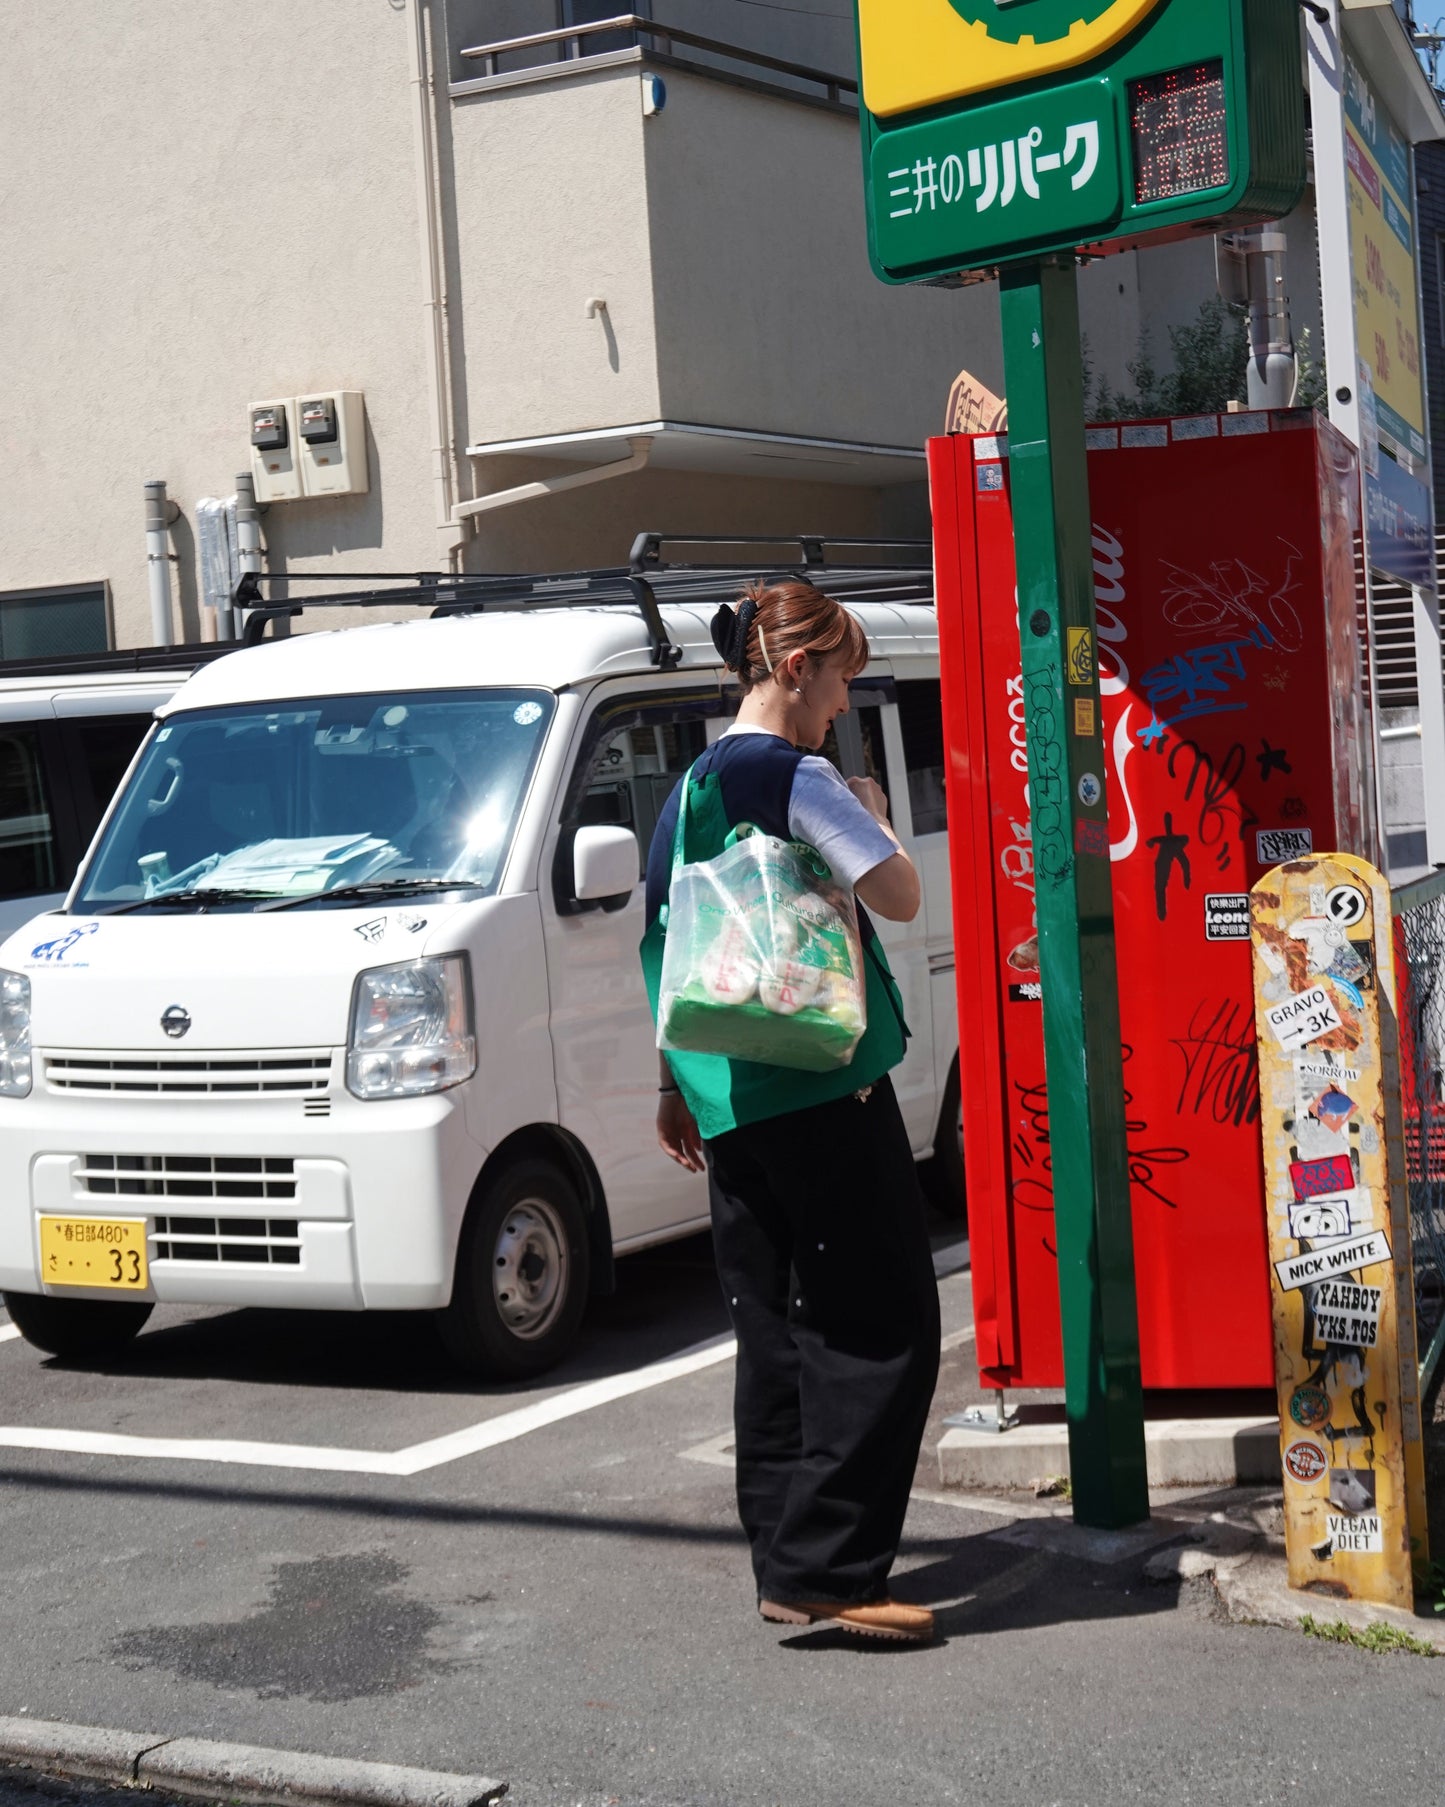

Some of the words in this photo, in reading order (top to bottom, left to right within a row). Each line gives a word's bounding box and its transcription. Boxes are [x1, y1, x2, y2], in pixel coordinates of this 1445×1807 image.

[887, 120, 1100, 218] 三井のリパーク
[1210, 924, 1248, 935] 平安回家
[1270, 990, 1325, 1025] GRAVO
[1306, 1008, 1337, 1033] 3K
[1305, 1063, 1358, 1081] SORROW
[1288, 1257, 1325, 1281] NICK
[1319, 1283, 1381, 1313] YAHBOY
[1317, 1313, 1377, 1345] YKS.TOS
[1329, 1517, 1379, 1533] VEGAN
[1338, 1535, 1371, 1550] DIET
